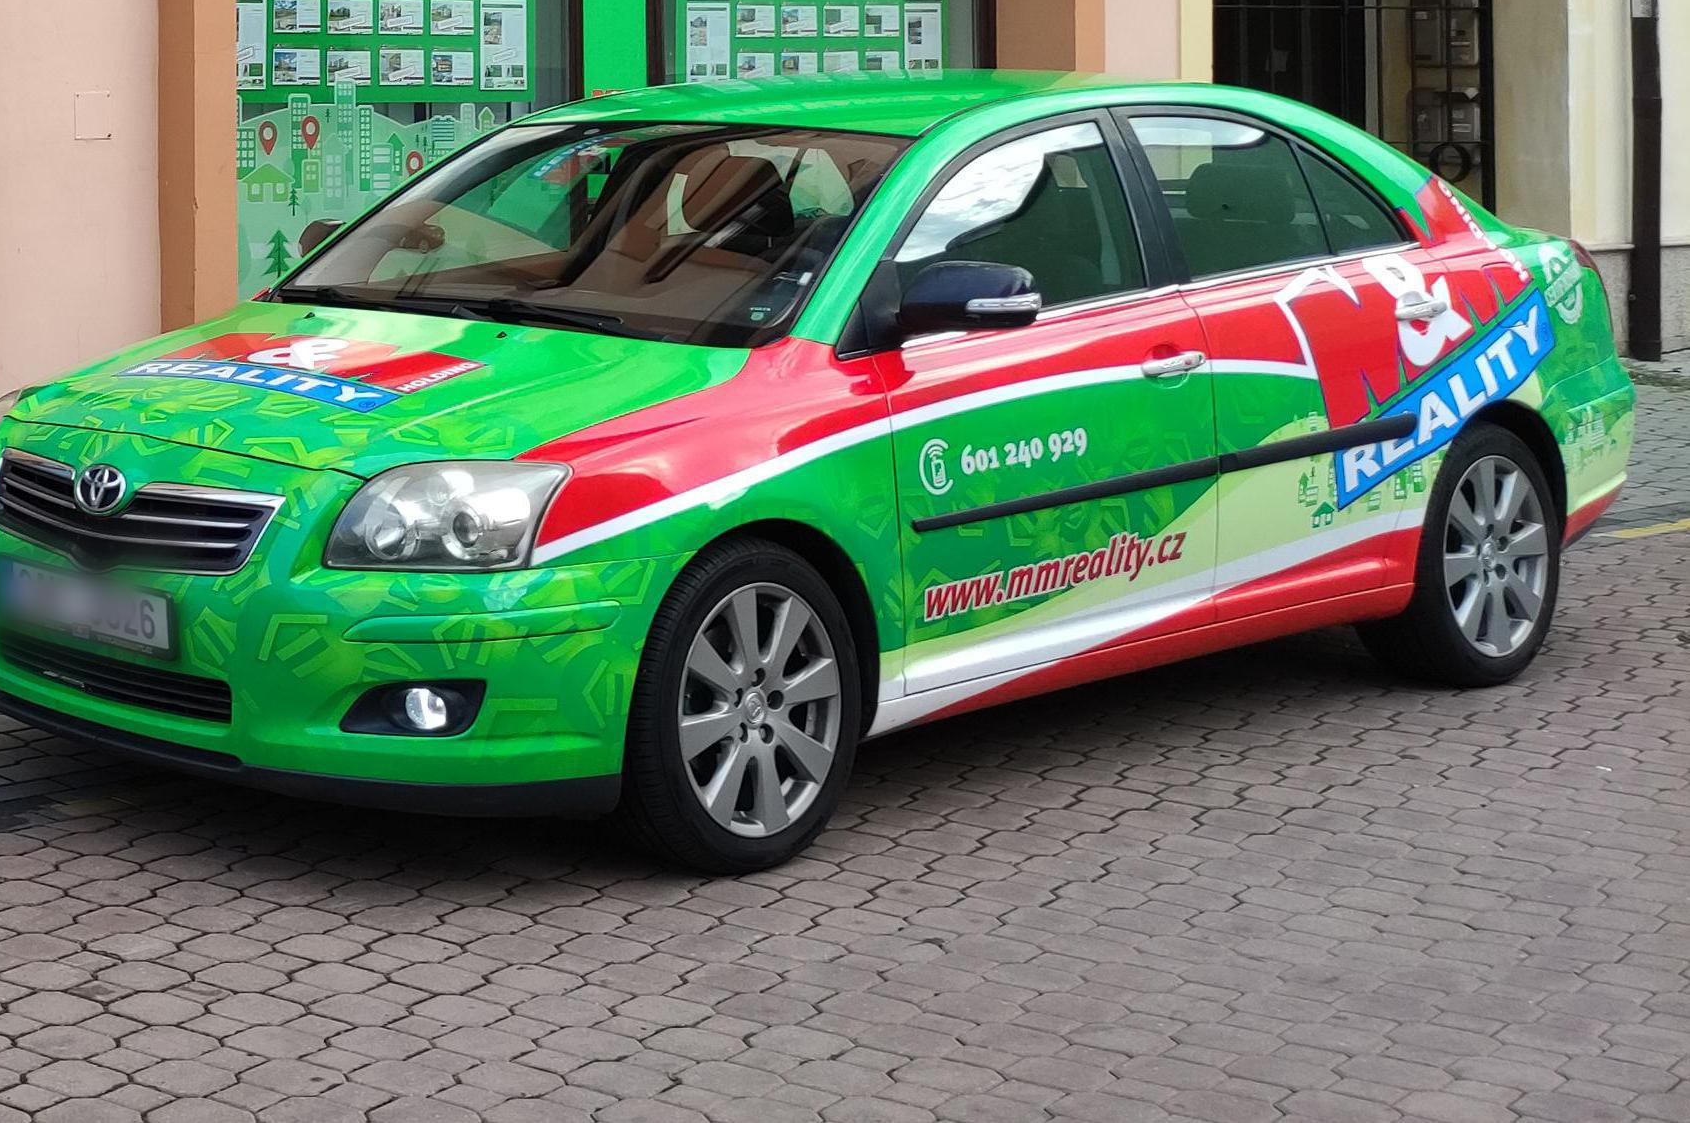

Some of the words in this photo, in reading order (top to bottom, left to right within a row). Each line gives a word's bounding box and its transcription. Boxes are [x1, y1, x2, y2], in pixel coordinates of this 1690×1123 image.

[127, 360, 383, 404] REALITY
[395, 362, 483, 393] HOLDING
[960, 444, 999, 475] 601
[1003, 437, 1043, 468] 240
[1047, 427, 1087, 462] 929
[923, 530, 1188, 623] www.mmreality.cz
